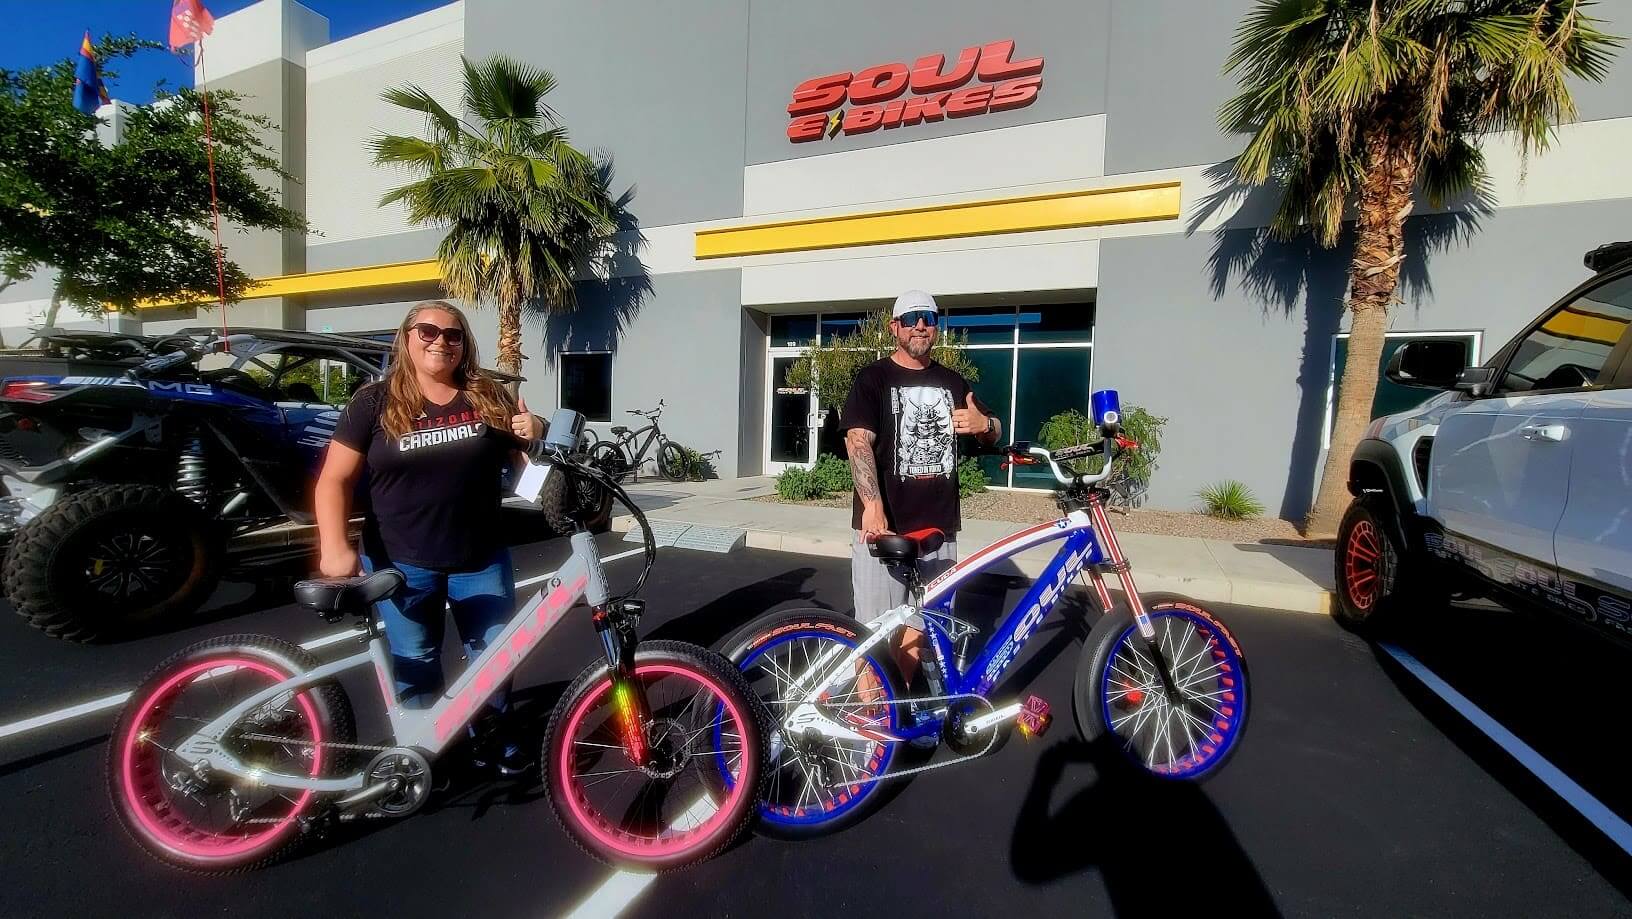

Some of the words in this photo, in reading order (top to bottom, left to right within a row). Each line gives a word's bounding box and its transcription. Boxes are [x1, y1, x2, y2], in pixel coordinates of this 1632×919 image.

[786, 39, 1045, 118] SOUL
[842, 77, 1043, 136] BIKES
[985, 541, 1092, 682] SOUL
